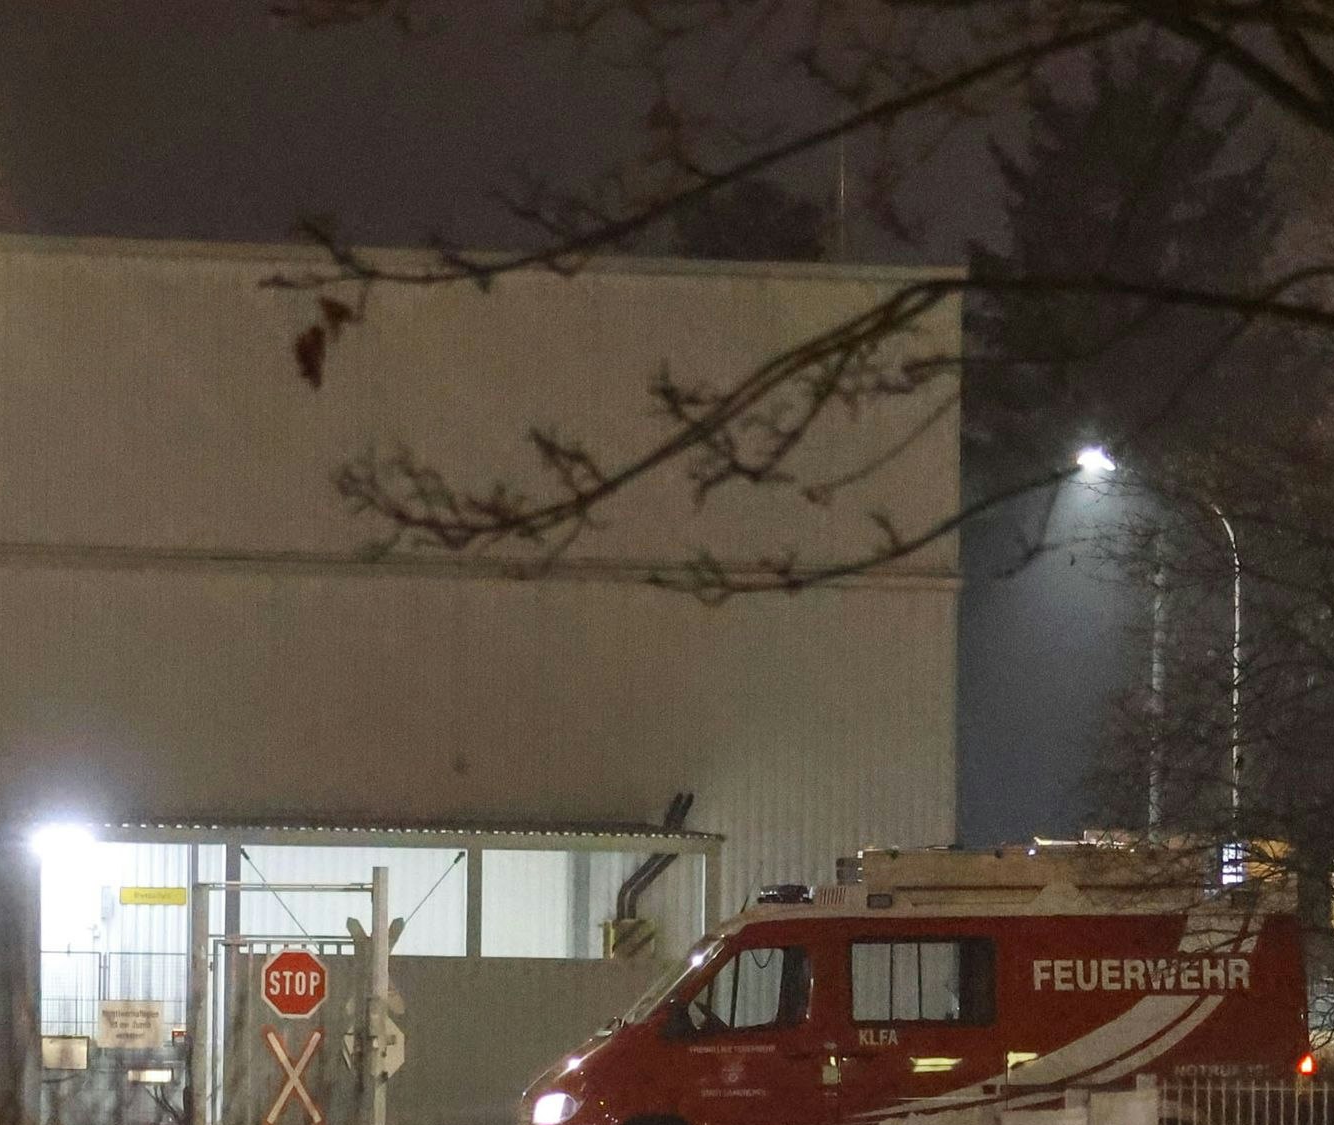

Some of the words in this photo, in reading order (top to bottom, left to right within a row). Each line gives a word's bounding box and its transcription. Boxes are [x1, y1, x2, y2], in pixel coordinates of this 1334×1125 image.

[269, 971, 321, 996] STOP
[1032, 958, 1251, 991] FEUERWEHR
[858, 1028, 899, 1046] KLFA
